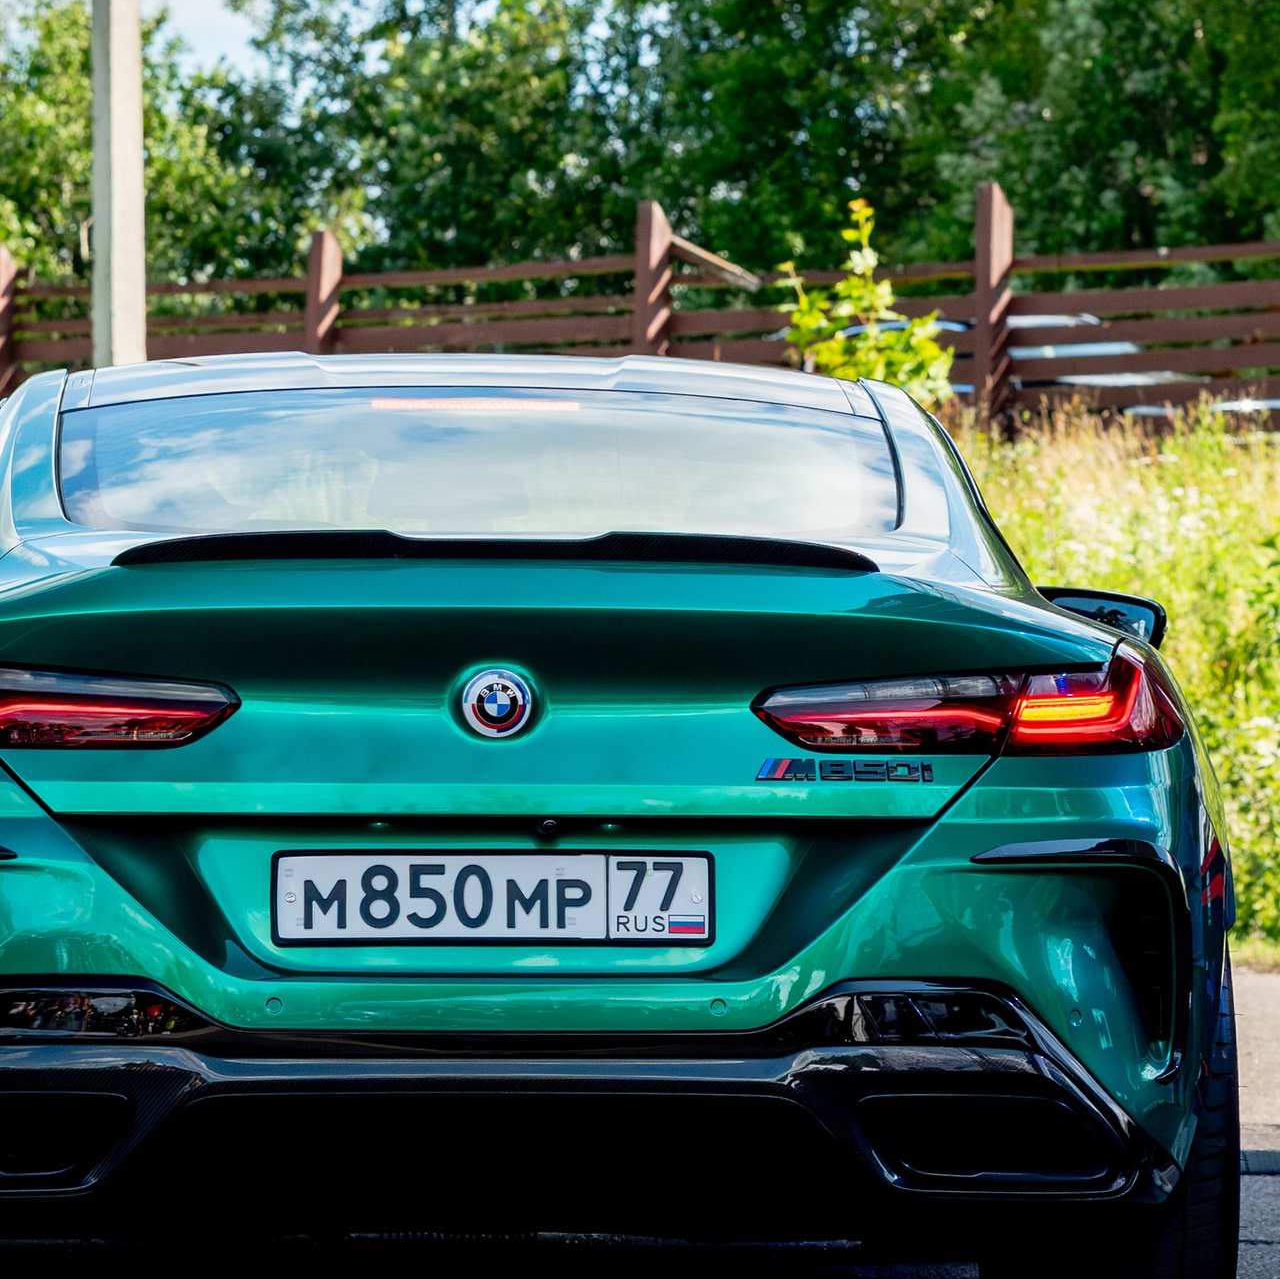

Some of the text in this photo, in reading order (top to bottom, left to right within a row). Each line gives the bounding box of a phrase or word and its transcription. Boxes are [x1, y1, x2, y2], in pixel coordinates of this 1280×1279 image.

[480, 683, 516, 698] BMW
[616, 861, 684, 912] 77
[616, 915, 667, 933] RUS
